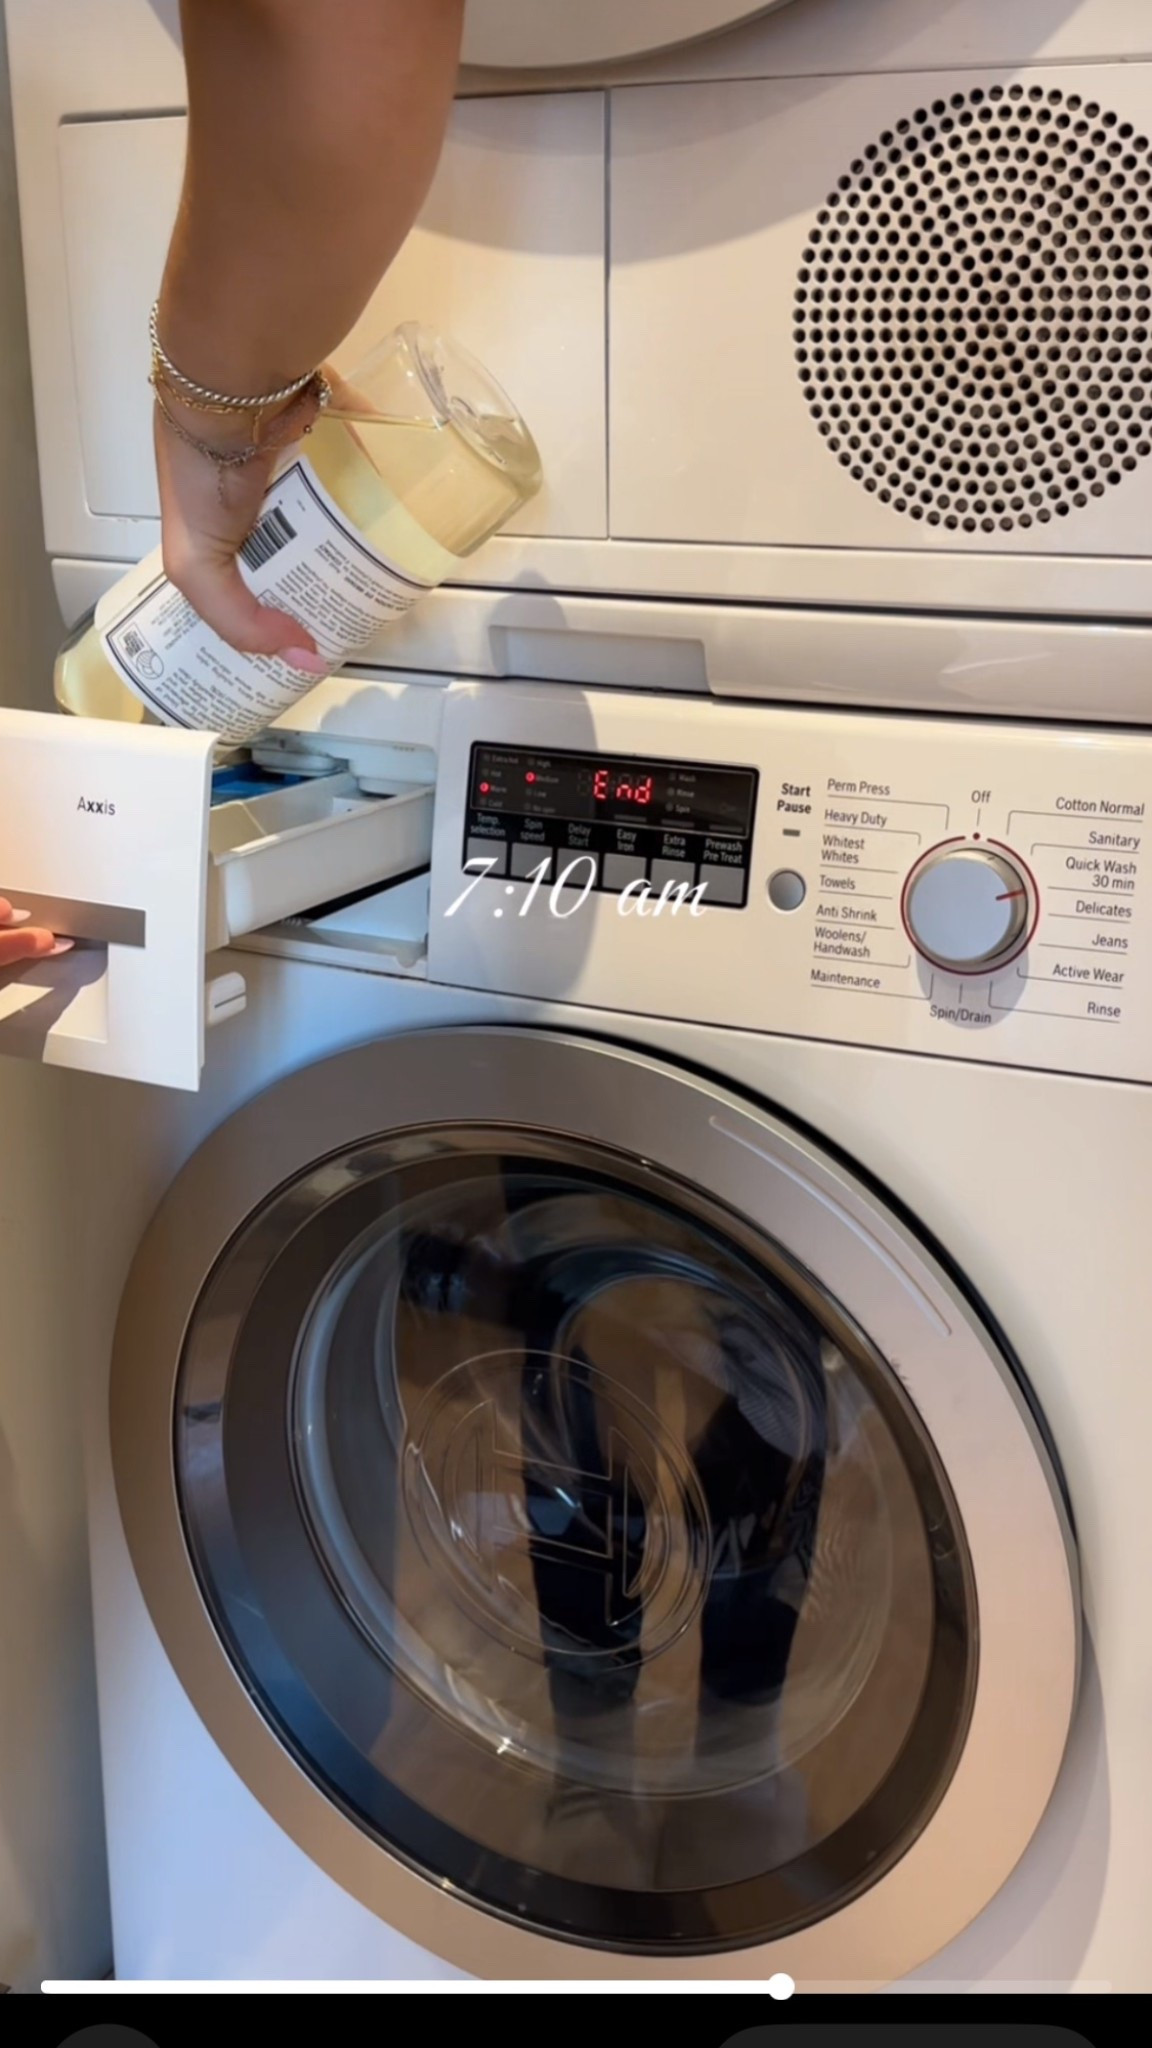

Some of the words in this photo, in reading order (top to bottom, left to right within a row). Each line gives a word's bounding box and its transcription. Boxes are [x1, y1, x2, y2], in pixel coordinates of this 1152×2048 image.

[781, 783, 811, 797] Start
[827, 779, 857, 792] Perm
[860, 782, 890, 796] Press
[971, 790, 991, 803] Off
[77, 796, 116, 815] Axxis
[777, 801, 811, 815] Pause
[1055, 797, 1097, 812] Cotton
[1101, 800, 1145, 816] Normal
[524, 818, 543, 830] Spin
[824, 809, 858, 825] Heavy
[860, 811, 887, 828] Duty
[568, 823, 591, 836] Delay
[617, 829, 637, 842] Easy
[569, 835, 588, 847] Start
[664, 833, 686, 846] Extra
[705, 839, 743, 852] Prewash
[822, 835, 865, 849] Whitest
[1088, 831, 1141, 848] Sanitary
[662, 845, 685, 858] Rinse
[703, 851, 719, 862] Pre
[721, 852, 743, 864] Treat
[821, 850, 860, 865] Whites
[1066, 857, 1101, 873] Quick
[1103, 860, 1137, 875] Wash
[819, 875, 856, 890] Towels
[1092, 875, 1109, 888] 30
[1112, 876, 1135, 890] min
[816, 905, 839, 918] Anti
[841, 907, 878, 922] Shrink
[1075, 900, 1132, 918] Delicates
[815, 927, 867, 944] Woolens/
[1091, 934, 1128, 949] Jeans
[813, 942, 871, 958] Handwash
[811, 969, 881, 988] Maintenance
[1052, 964, 1091, 979] Active
[1092, 967, 1125, 983] Wear
[929, 1005, 992, 1024] Spin/Drain
[1087, 1002, 1121, 1017] Rinse
